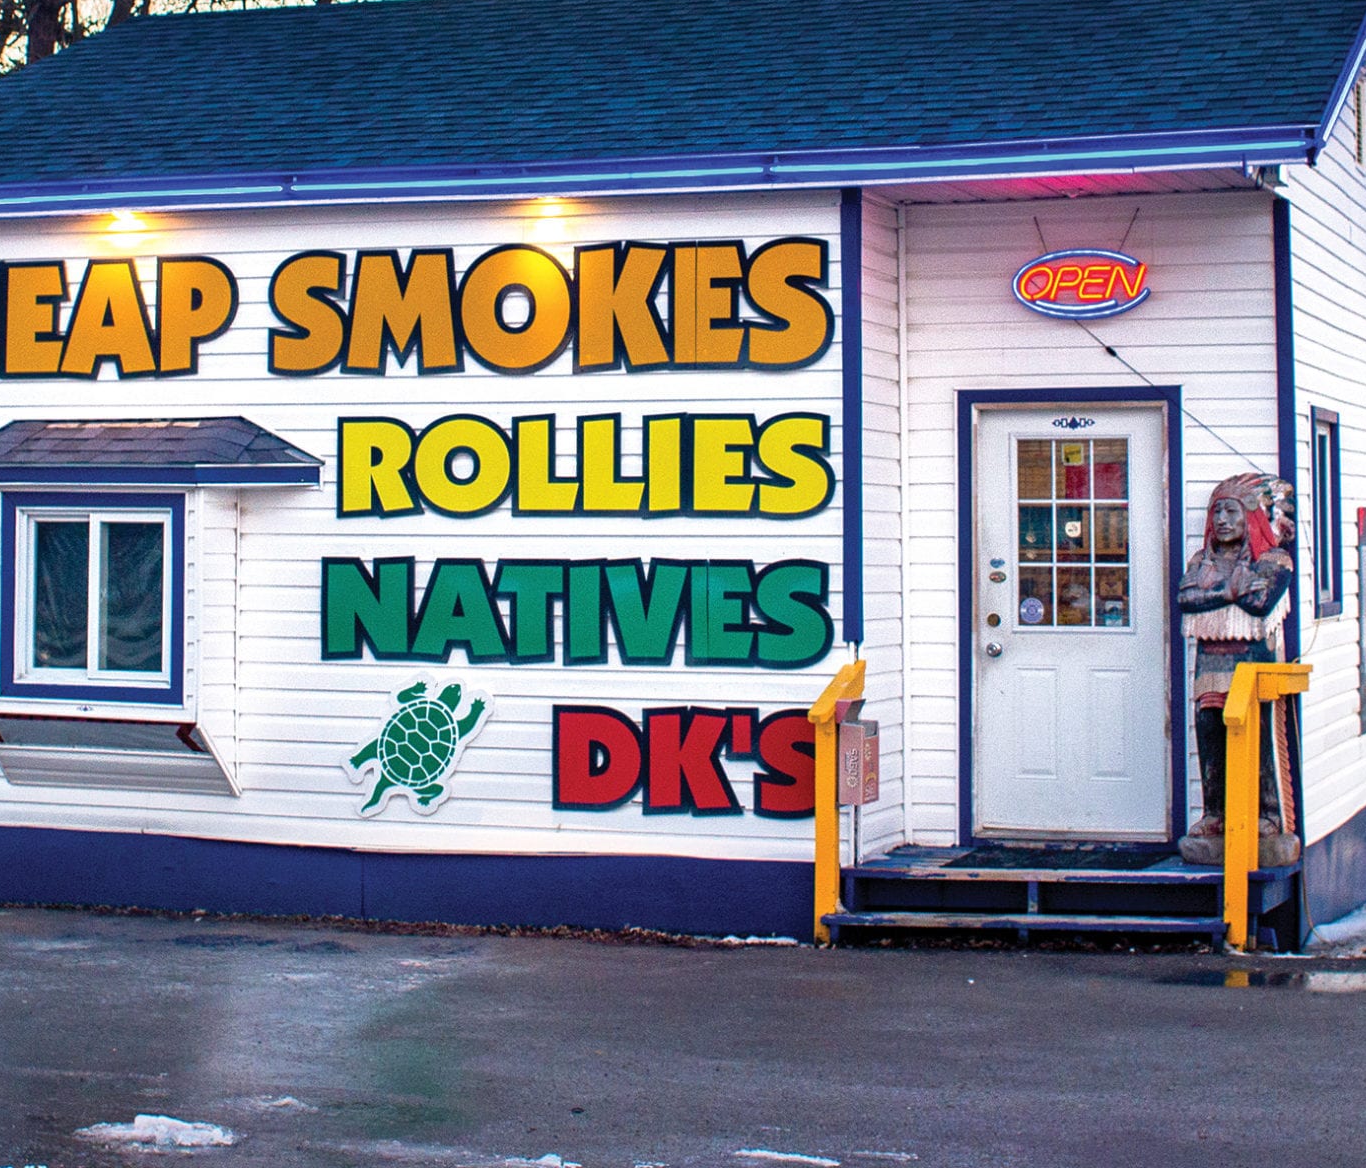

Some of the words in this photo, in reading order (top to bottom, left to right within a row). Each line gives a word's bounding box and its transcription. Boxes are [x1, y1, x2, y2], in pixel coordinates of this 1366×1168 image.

[267, 236, 836, 377] SMOKES
[1019, 262, 1148, 301] OPEN
[336, 412, 837, 519] ROLLIES
[320, 556, 835, 670] NATIVES
[551, 705, 817, 820] DK'S
